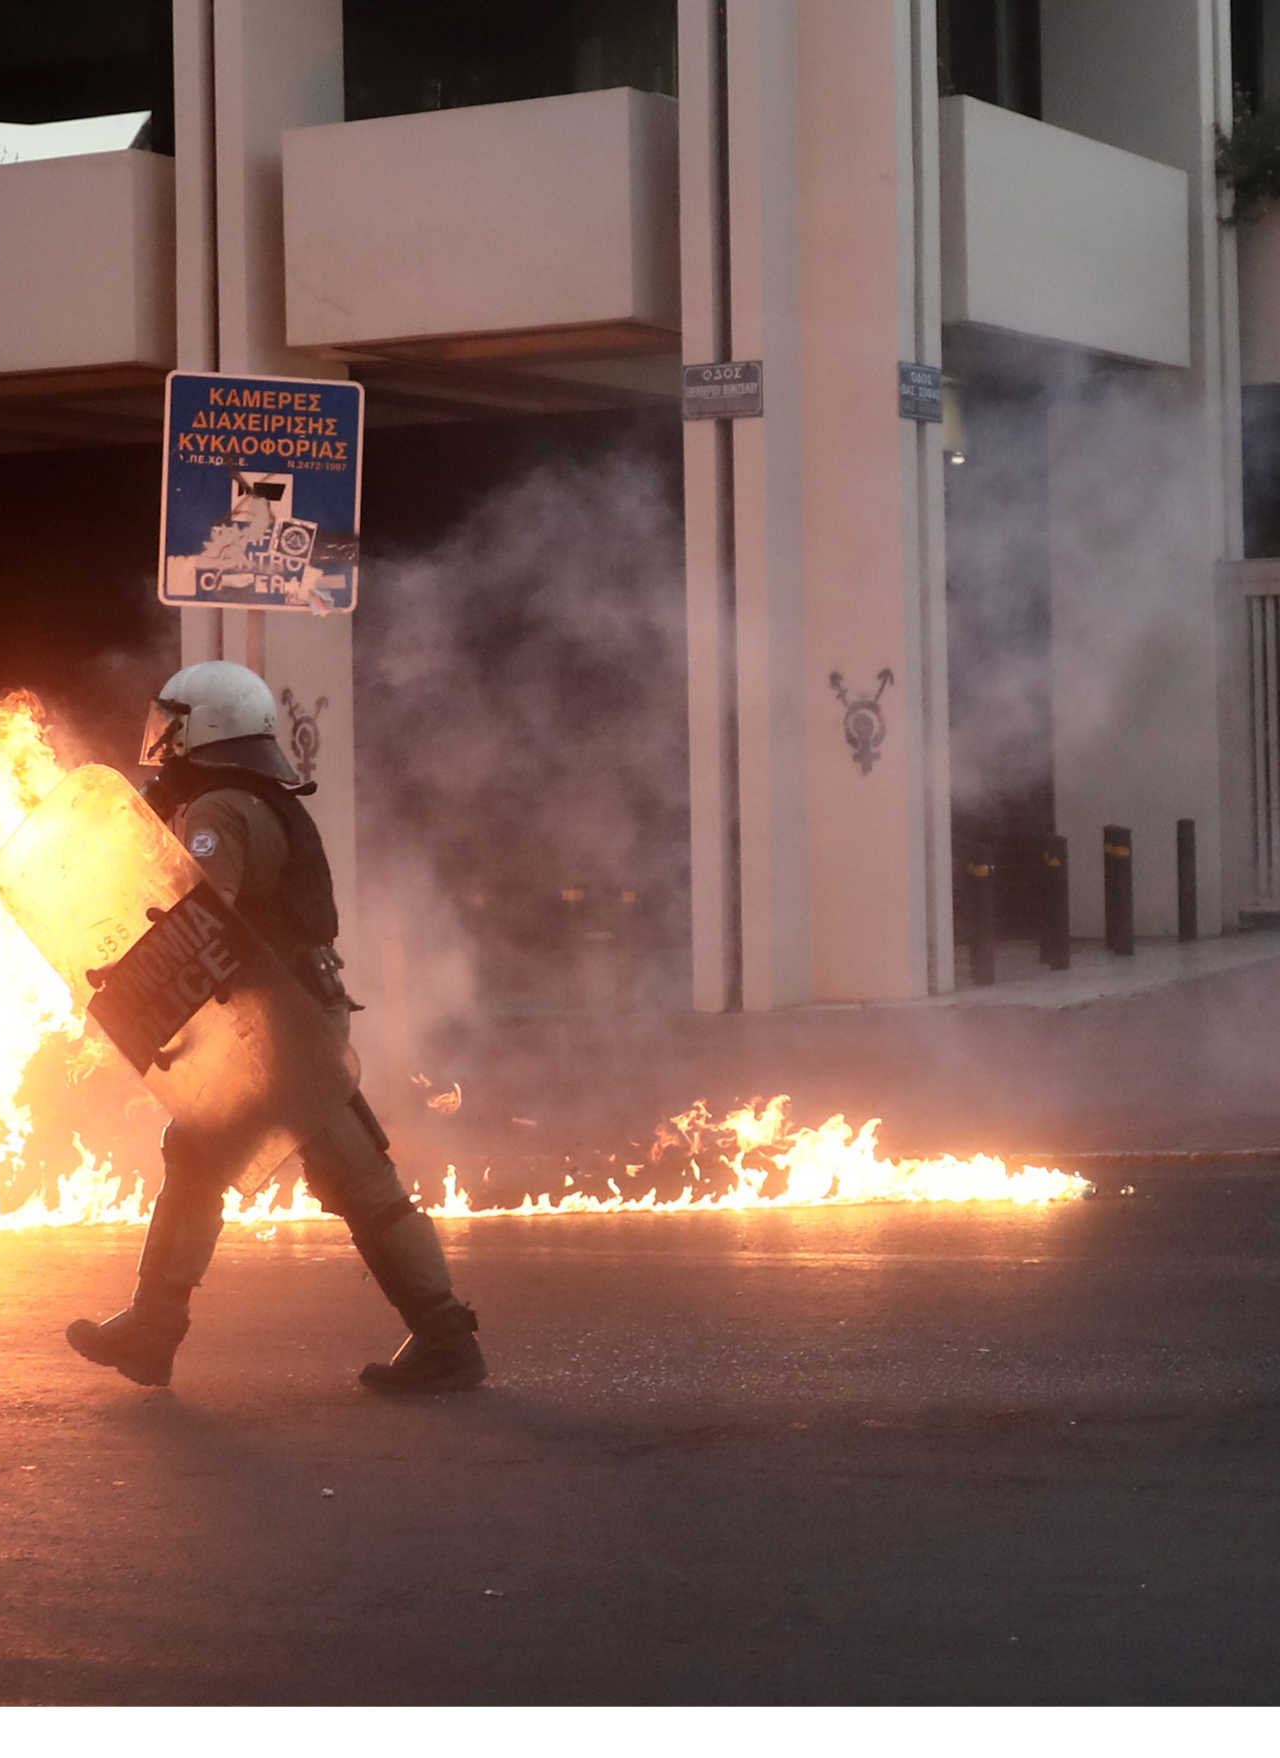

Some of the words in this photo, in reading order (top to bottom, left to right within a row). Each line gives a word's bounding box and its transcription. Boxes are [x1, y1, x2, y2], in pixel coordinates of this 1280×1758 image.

[209, 387, 322, 412] ΚΑΜΕΡΕΣ
[192, 410, 338, 436] ΔΙΑΧΕΙΡΙΣΗΣ
[178, 433, 348, 460] ΚΥΚΛΟΦΟΡΙΑΣ
